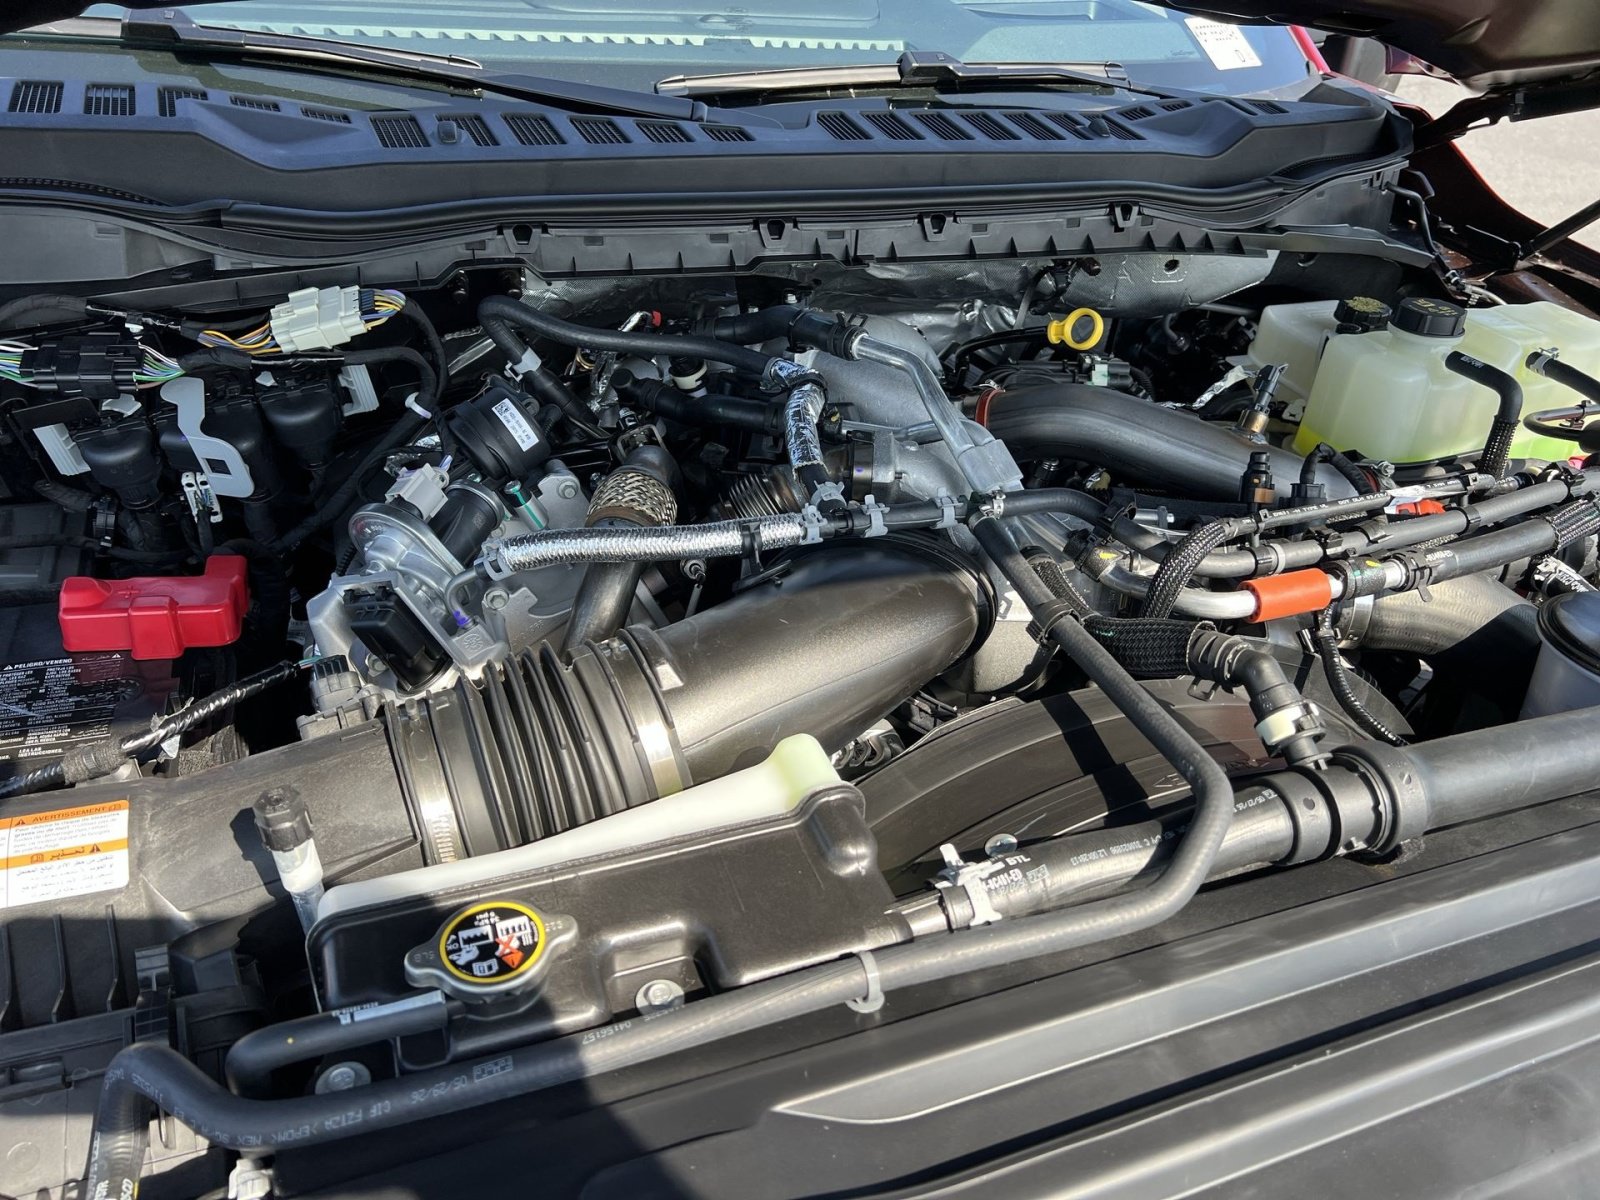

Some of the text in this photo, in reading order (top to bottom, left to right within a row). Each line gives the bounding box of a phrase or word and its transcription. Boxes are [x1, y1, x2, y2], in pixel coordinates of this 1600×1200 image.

[14, 658, 73, 669] PELIGRO/VENENO
[31, 806, 106, 823] AVERTISSEMENT
[1005, 853, 1031, 867] BTL
[446, 942, 459, 951] OK
